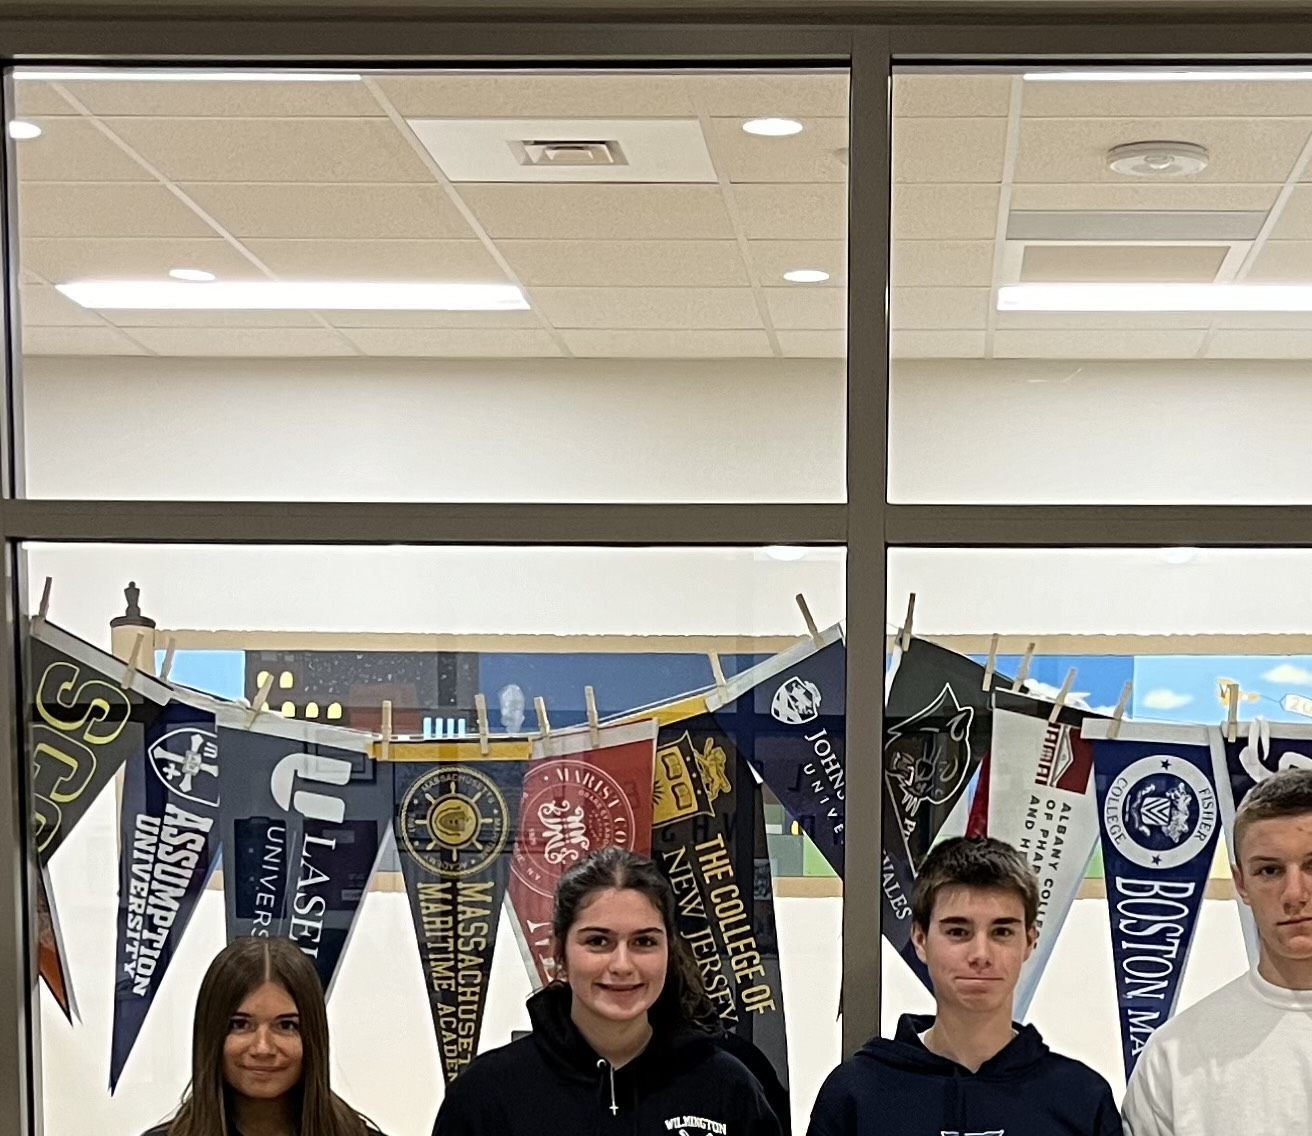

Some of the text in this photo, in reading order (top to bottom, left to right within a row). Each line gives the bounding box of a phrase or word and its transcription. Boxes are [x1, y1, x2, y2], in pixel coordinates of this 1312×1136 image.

[556, 767, 621, 810] MARIST
[1024, 795, 1041, 830] AND
[1043, 799, 1056, 822] OF
[1106, 777, 1128, 846] COLLEGE
[1194, 787, 1214, 842] FISHER
[694, 833, 734, 884] THE
[1048, 802, 1072, 871] ALBANY
[123, 814, 162, 979] UNIVERSITY
[132, 803, 215, 997] ASSUMPTION
[661, 845, 708, 920] NEW
[416, 881, 456, 992] MARITIME
[709, 884, 766, 984] COLLEGE
[680, 925, 739, 1026] JERSEY
[740, 983, 777, 1015] OF
[664, 1115, 727, 1136] WILMINGTON
